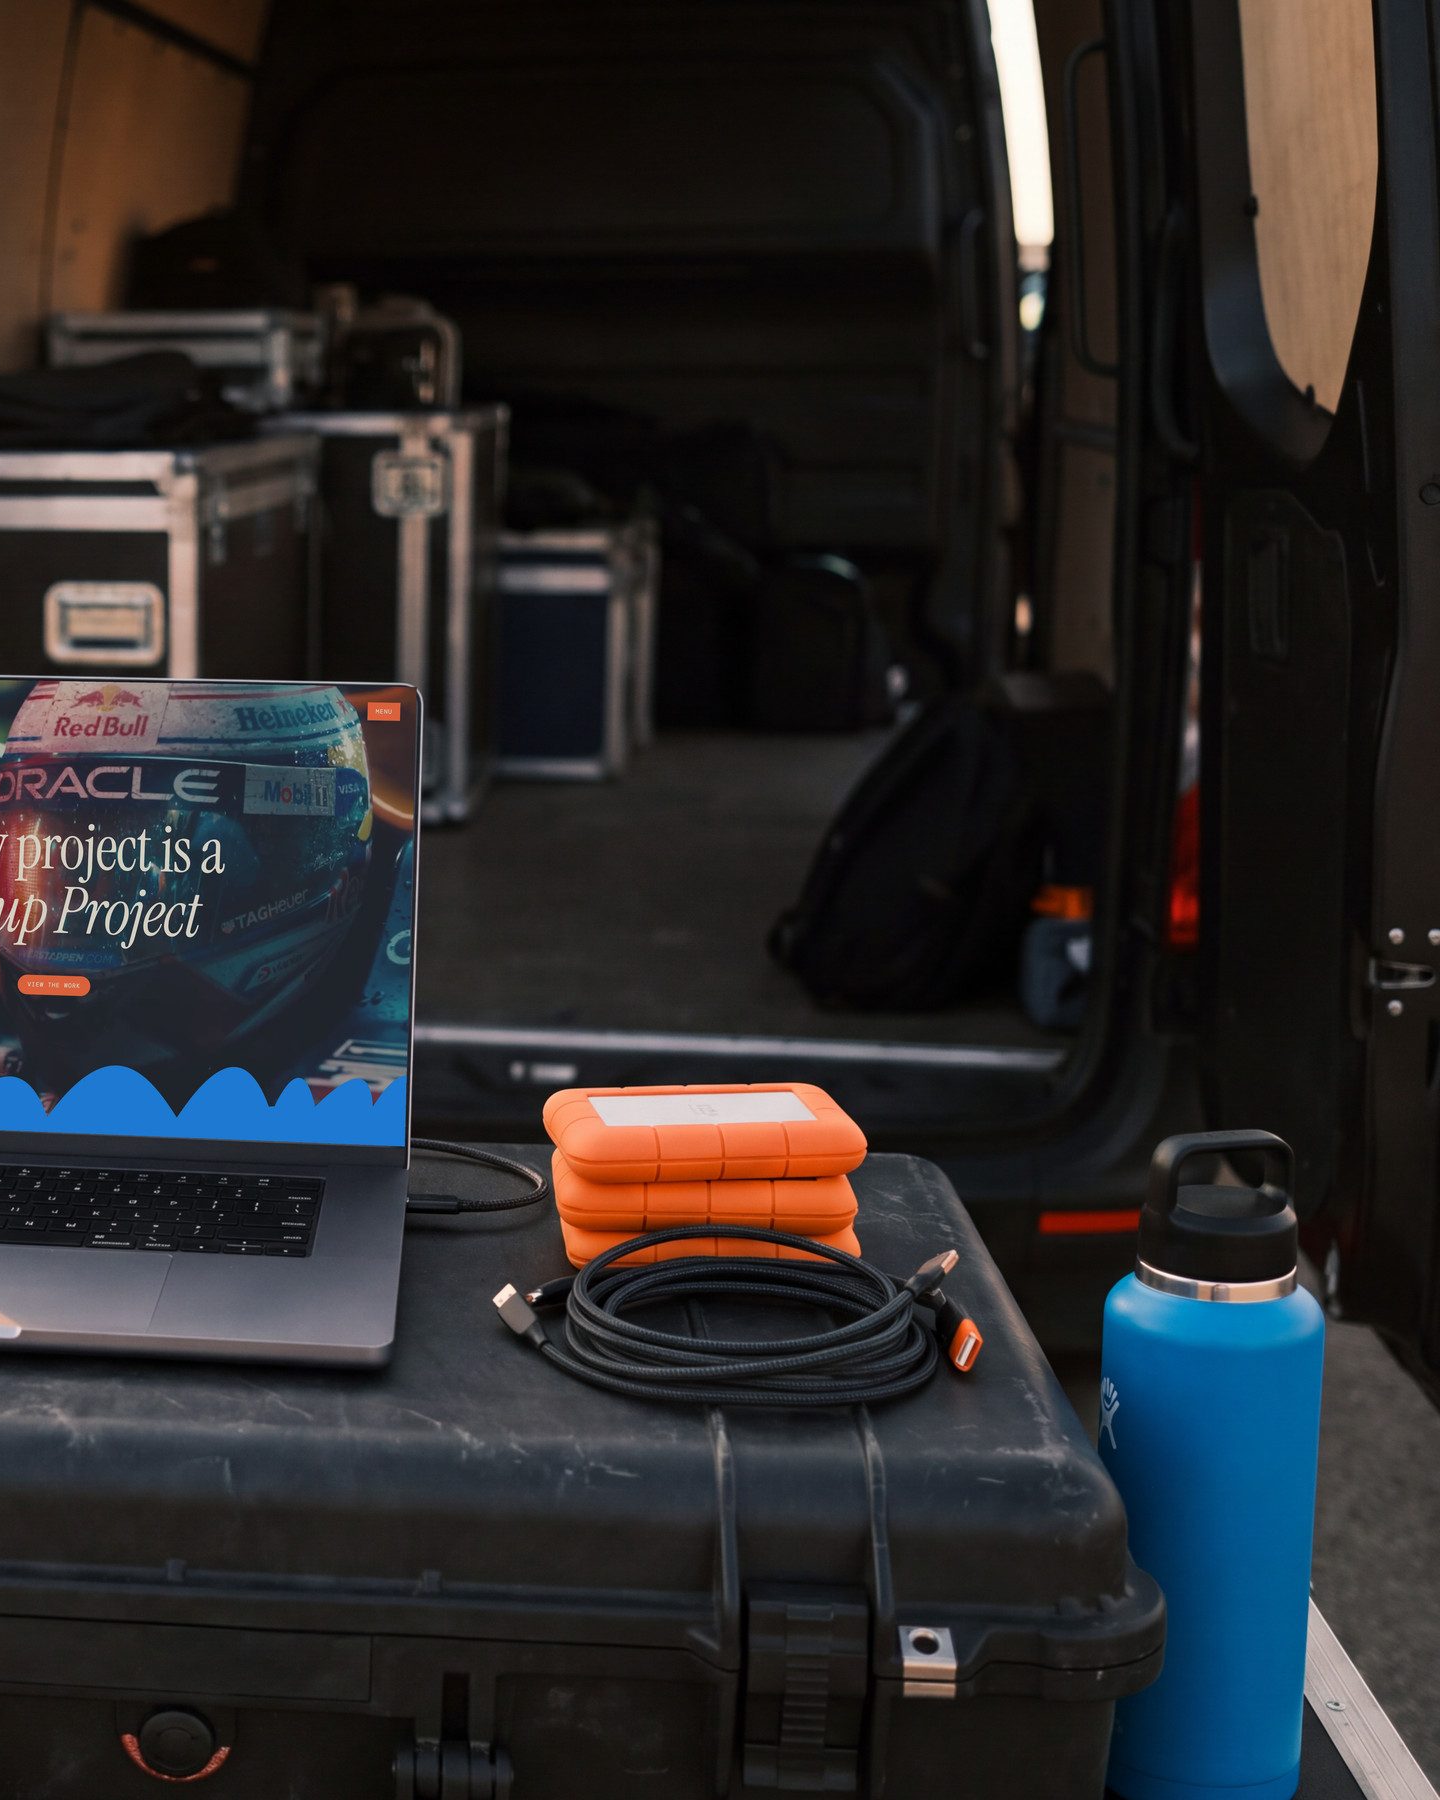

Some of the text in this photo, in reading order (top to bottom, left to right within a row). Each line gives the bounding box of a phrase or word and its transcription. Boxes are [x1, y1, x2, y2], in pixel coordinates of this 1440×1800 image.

[53, 713, 149, 737] Red Bull
[234, 699, 338, 732] Heineken
[338, 784, 361, 795] VISA
[14, 823, 152, 884] project
[160, 825, 191, 873] is
[200, 838, 226, 874] a
[52, 886, 204, 950] Project
